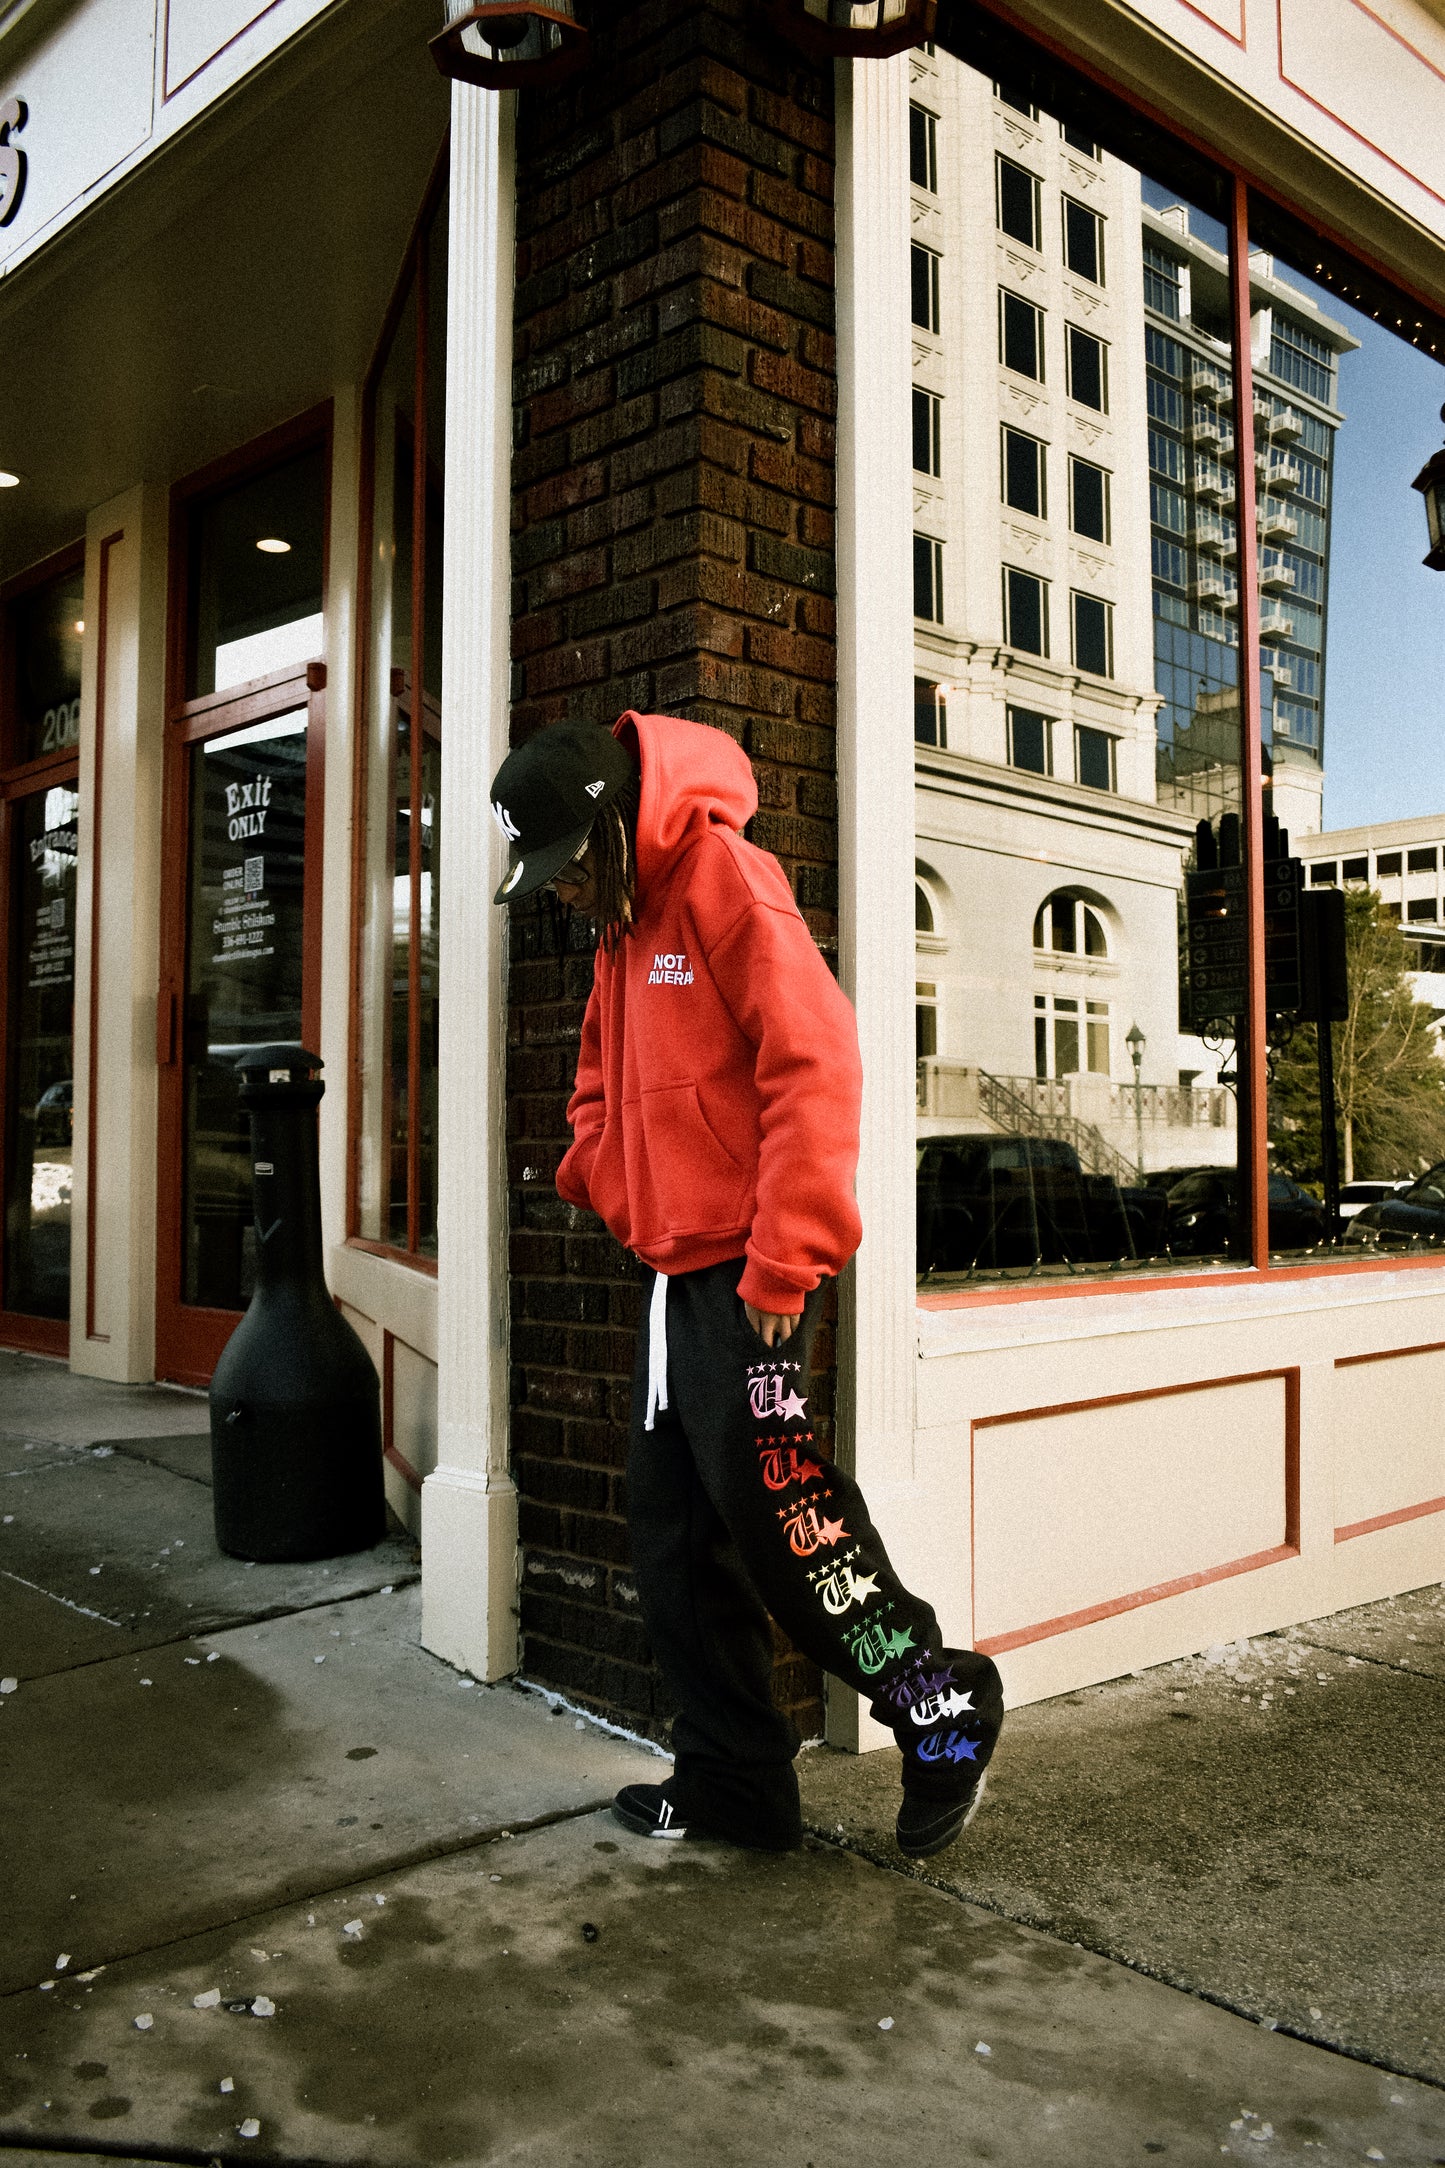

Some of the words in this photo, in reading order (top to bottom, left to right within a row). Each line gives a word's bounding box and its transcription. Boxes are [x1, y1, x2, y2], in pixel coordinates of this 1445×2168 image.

[224, 774, 272, 817] Exit
[228, 810, 267, 841] ONLY
[653, 953, 686, 970] NOT
[647, 969, 695, 985] AVERA
